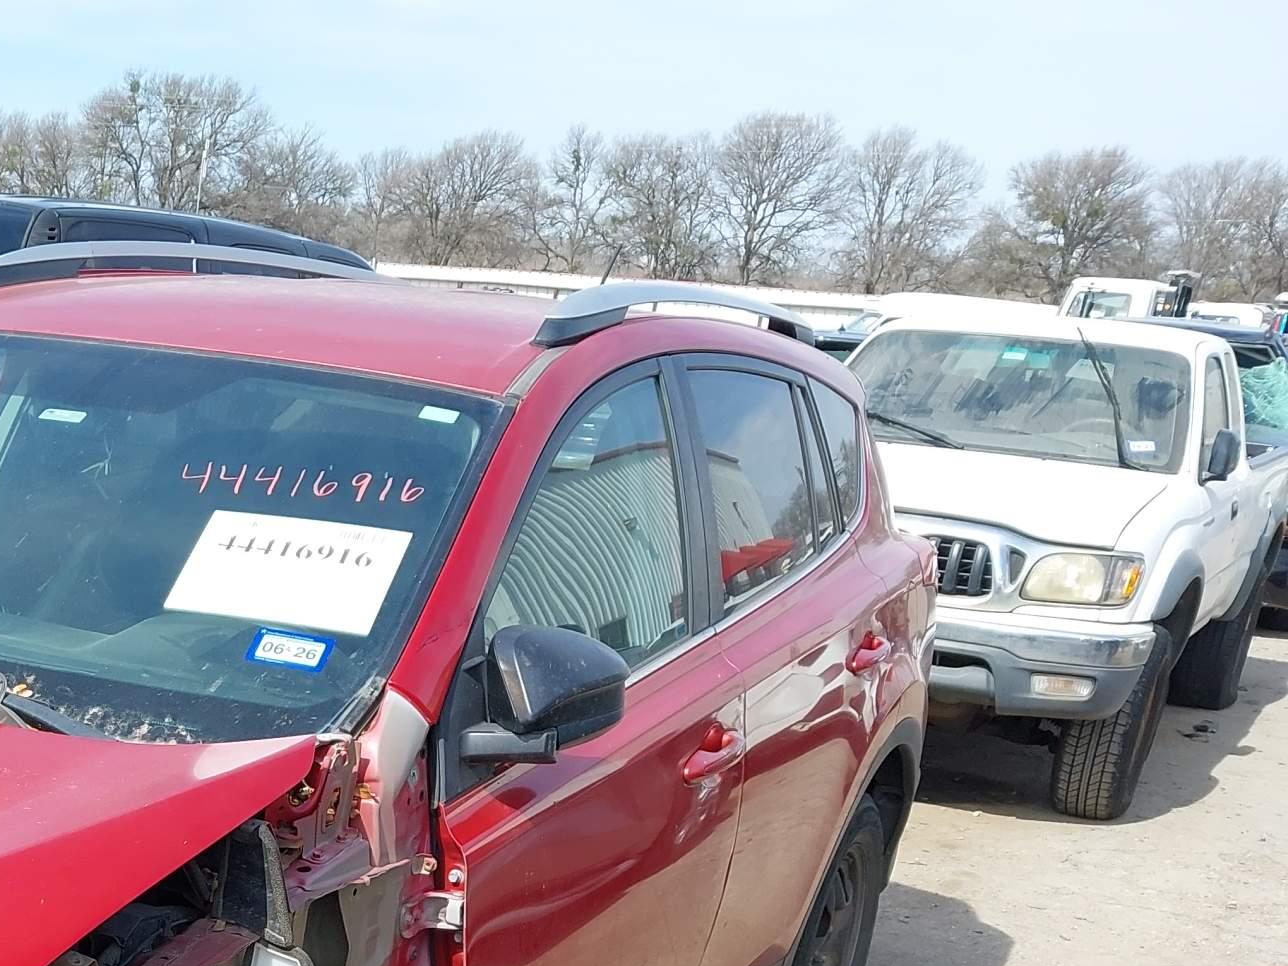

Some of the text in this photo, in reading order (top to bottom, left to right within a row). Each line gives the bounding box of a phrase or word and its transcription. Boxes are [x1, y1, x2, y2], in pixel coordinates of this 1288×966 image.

[182, 461, 425, 503] 44416916
[217, 534, 373, 568] 44416916
[293, 646, 318, 660] 26
